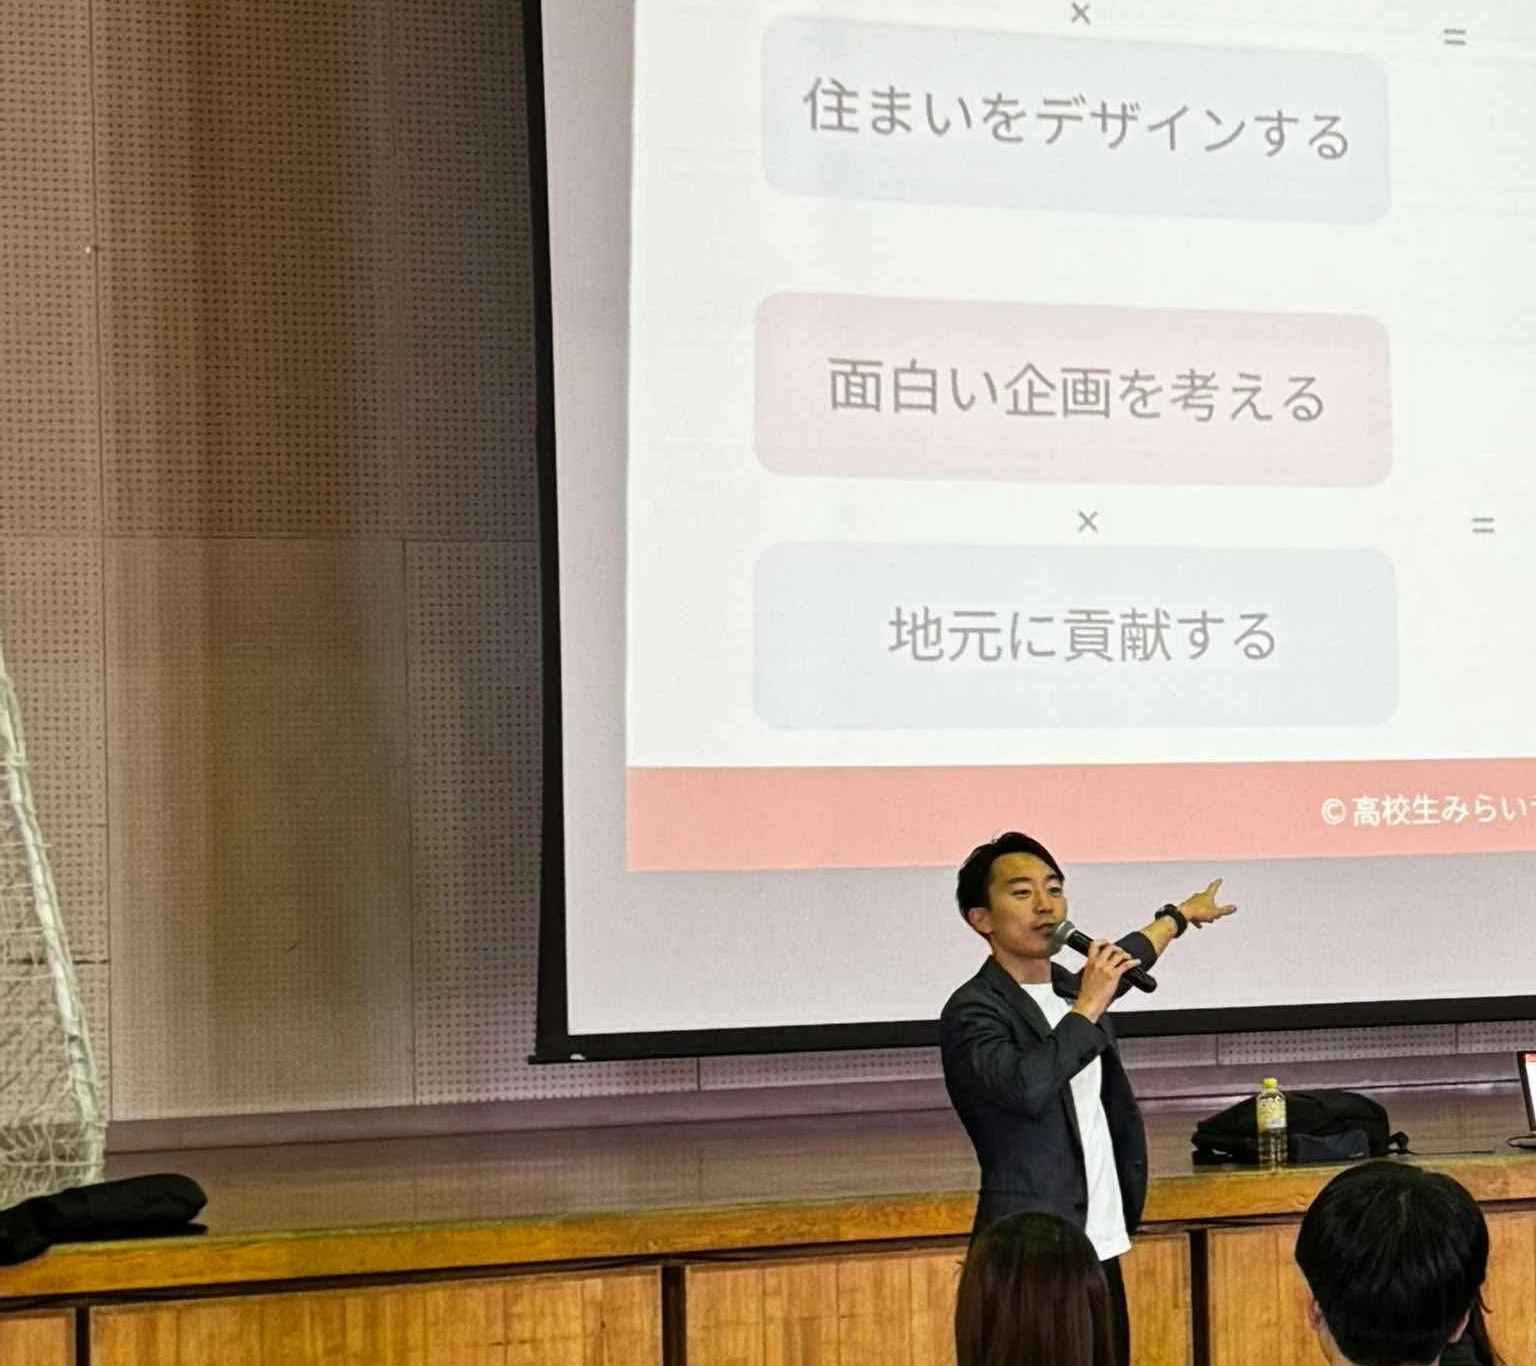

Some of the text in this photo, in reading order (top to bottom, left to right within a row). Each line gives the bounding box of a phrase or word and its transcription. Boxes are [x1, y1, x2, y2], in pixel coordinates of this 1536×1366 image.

[802, 76, 1350, 161] 住まいをデザインする
[827, 356, 1326, 424] 面白い企画を考える
[887, 605, 1278, 664] 地元に貢献する
